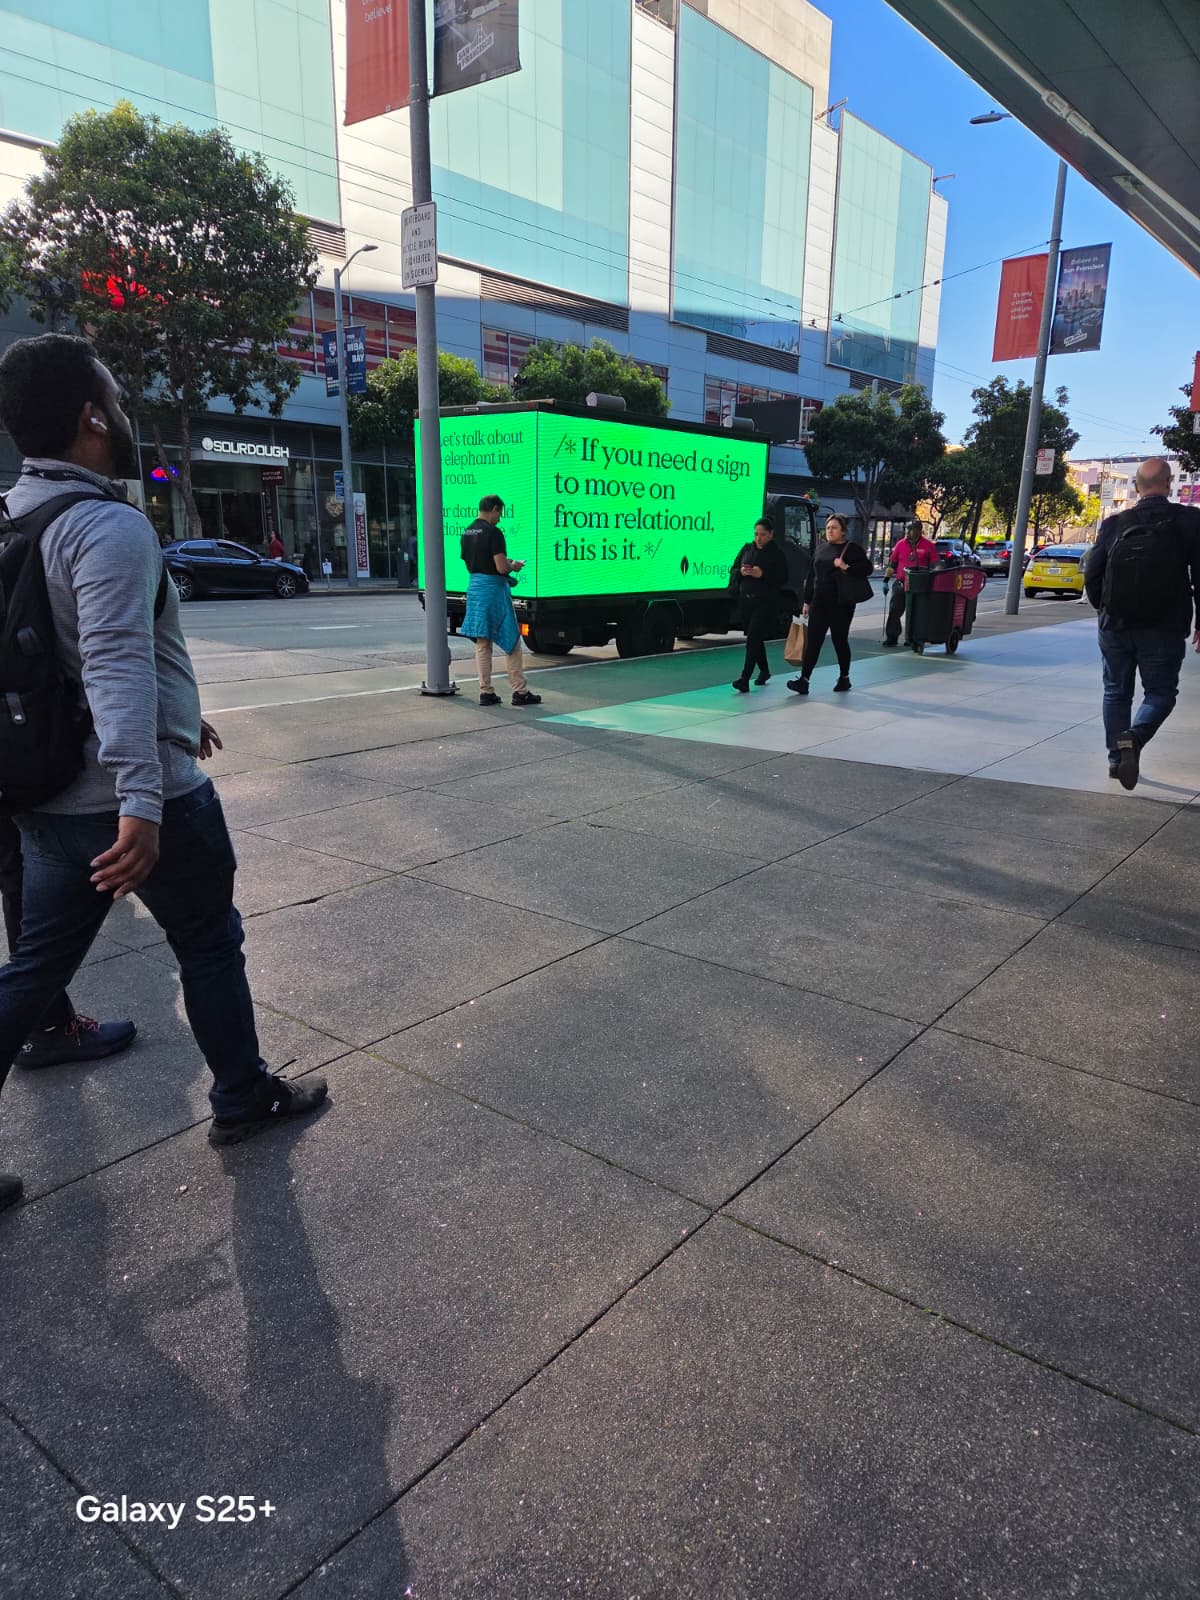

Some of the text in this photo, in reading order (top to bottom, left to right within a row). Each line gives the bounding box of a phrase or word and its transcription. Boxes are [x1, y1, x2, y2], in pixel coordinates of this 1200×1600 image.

[352, 354, 364, 363] BAY
[442, 429, 524, 446] et's talk about
[212, 440, 290, 458] SOURDOUGH
[444, 450, 510, 470] elephant in
[581, 437, 600, 462] If
[602, 446, 643, 470] you
[648, 450, 698, 472] need
[701, 456, 714, 473] a
[716, 454, 751, 482] sign
[445, 473, 478, 485] room.
[554, 472, 676, 500] to move on
[554, 504, 714, 533] from relational,
[553, 538, 596, 561] this
[600, 538, 618, 561] is
[622, 538, 640, 560] it.
